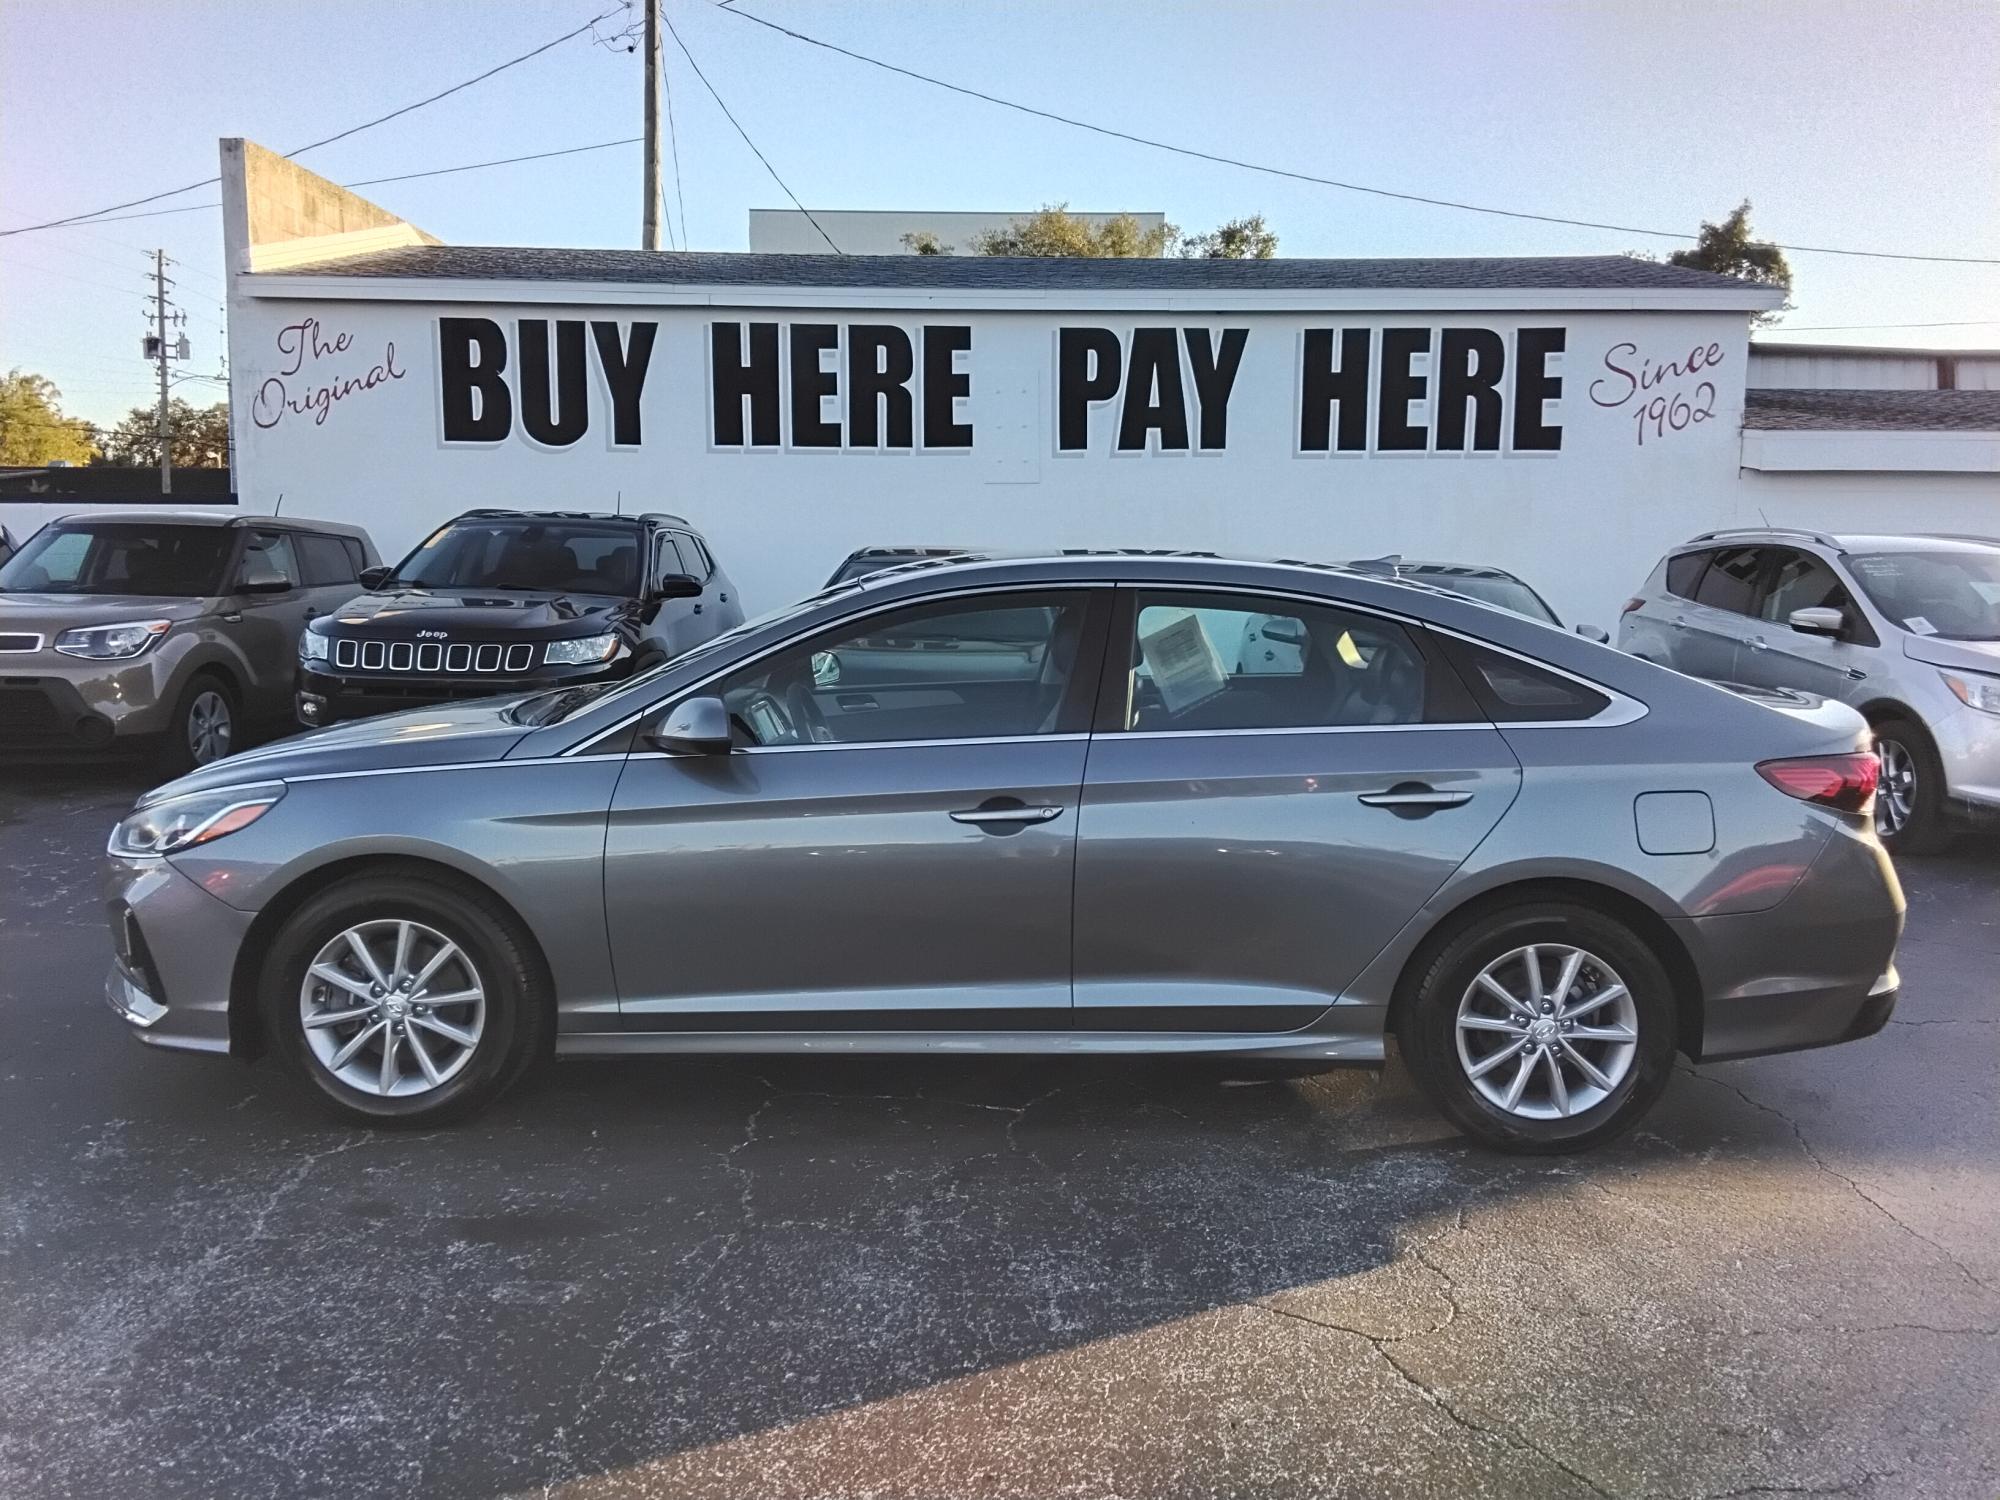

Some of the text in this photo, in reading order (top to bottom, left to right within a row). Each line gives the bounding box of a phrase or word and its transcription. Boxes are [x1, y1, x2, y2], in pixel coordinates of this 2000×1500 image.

[277, 317, 354, 377] The
[1589, 341, 1725, 408] Since
[251, 342, 407, 430] Original
[439, 317, 1566, 451] BUY HERE PAY HERE
[1632, 381, 1716, 447] 1962
[416, 630, 448, 639] Jeep
